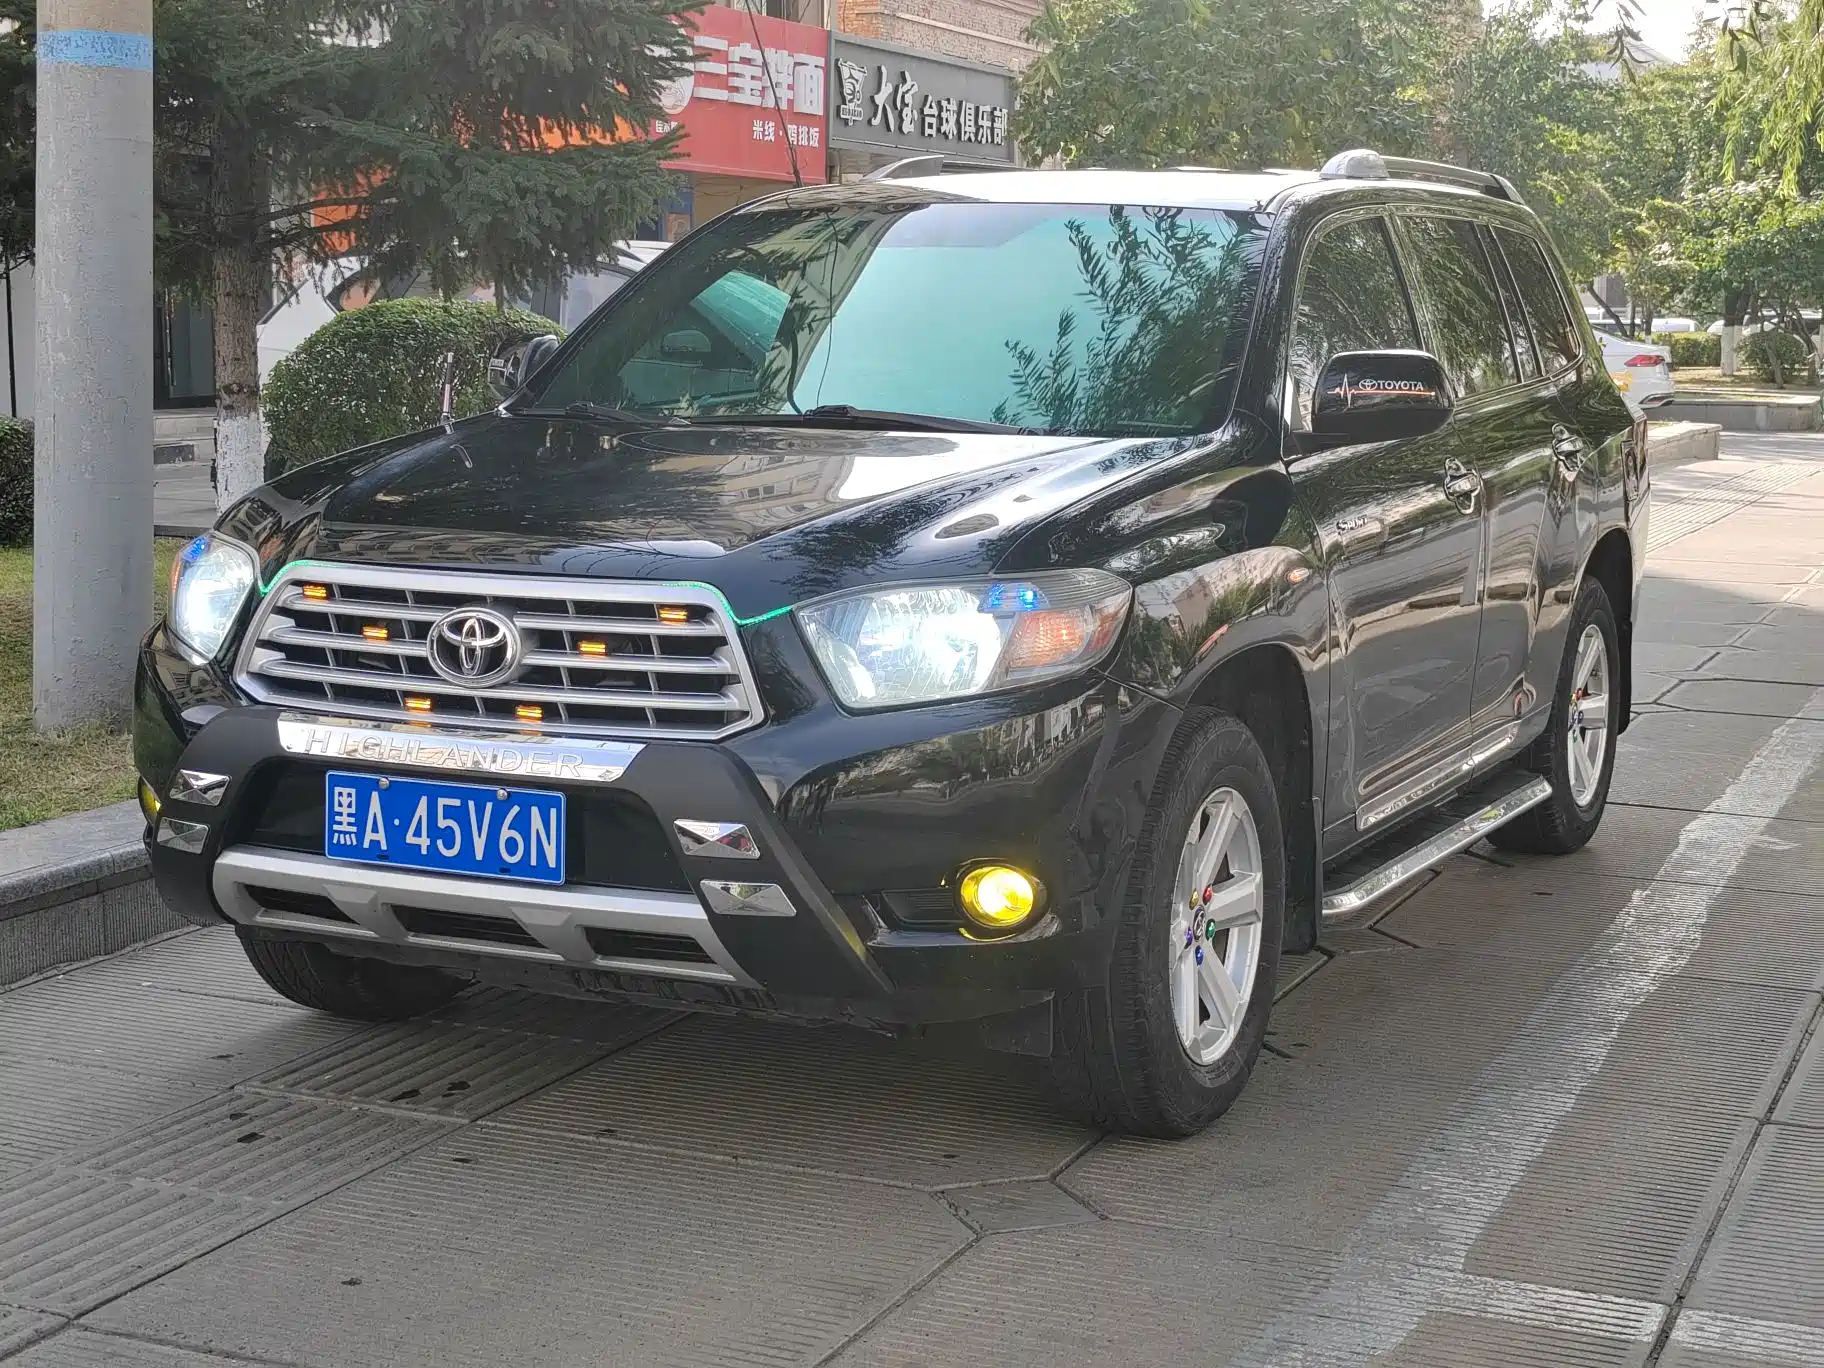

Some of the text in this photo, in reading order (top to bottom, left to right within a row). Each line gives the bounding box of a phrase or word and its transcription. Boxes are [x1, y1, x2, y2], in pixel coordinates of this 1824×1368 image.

[870, 64, 1009, 146] 大宝台球俱乐部
[1378, 380, 1424, 391] TOYOTA
[304, 727, 584, 778] HIGHLANDER
[332, 786, 557, 869] 黑A·45V6N
